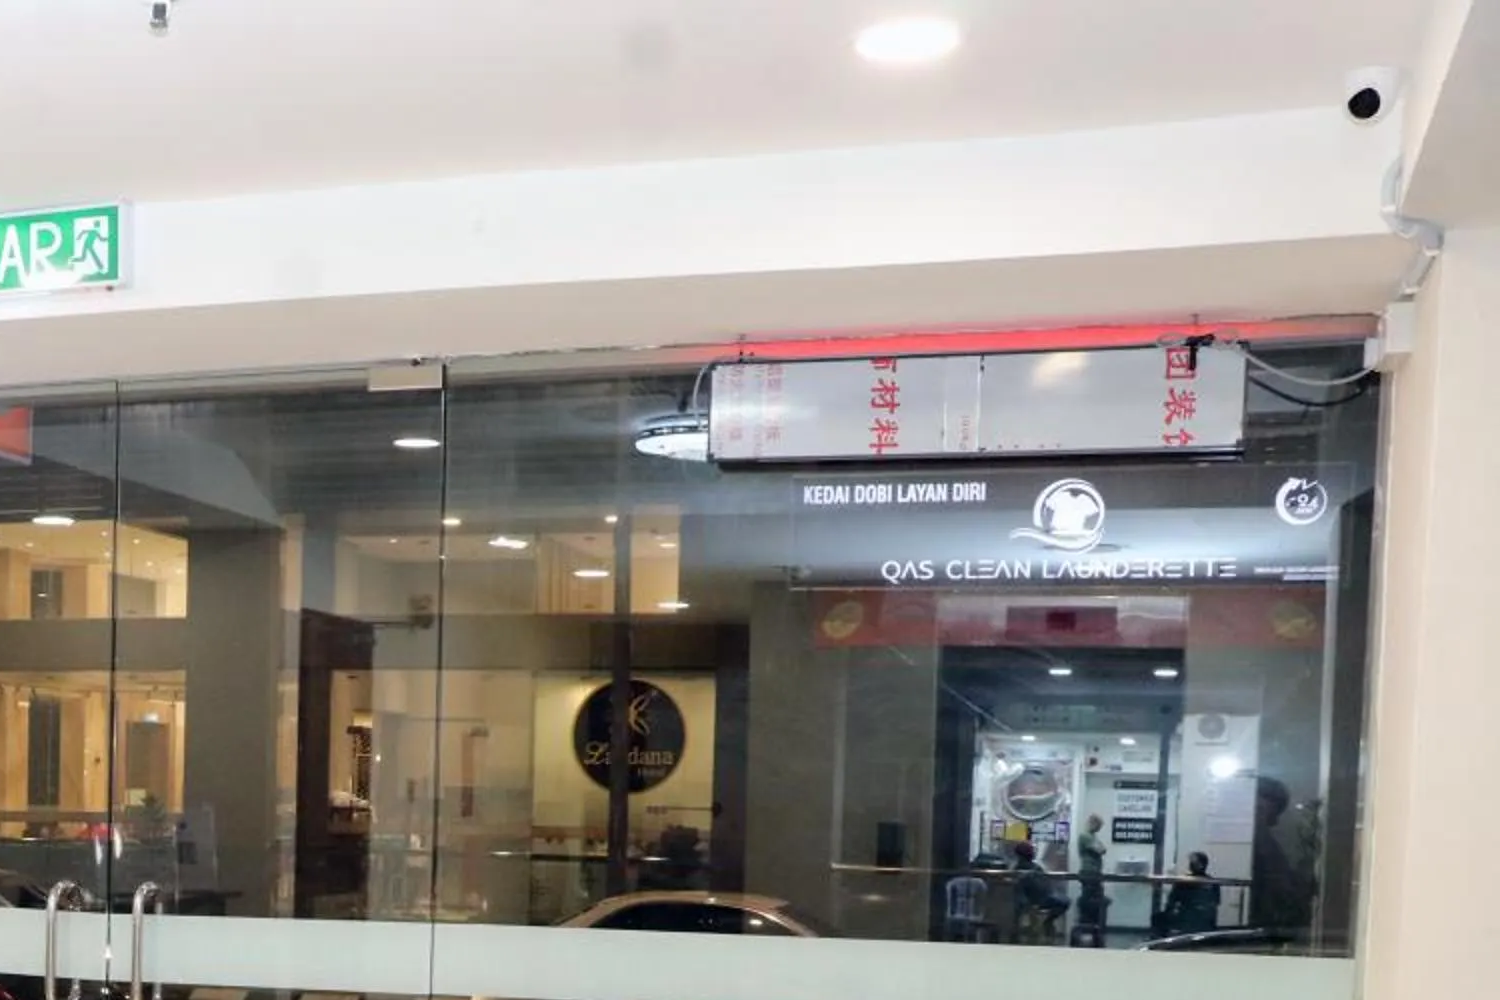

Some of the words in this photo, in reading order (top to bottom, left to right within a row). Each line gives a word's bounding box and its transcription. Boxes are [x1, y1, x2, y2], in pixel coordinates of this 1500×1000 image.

[803, 485, 849, 504] KEDAI
[854, 484, 893, 504] DOBI
[897, 483, 948, 503] LAYAN
[952, 482, 987, 501] DIRI
[881, 559, 935, 585] QAS
[946, 558, 1032, 580] CLEAN
[1041, 557, 1237, 579] LAUNDERETTE
